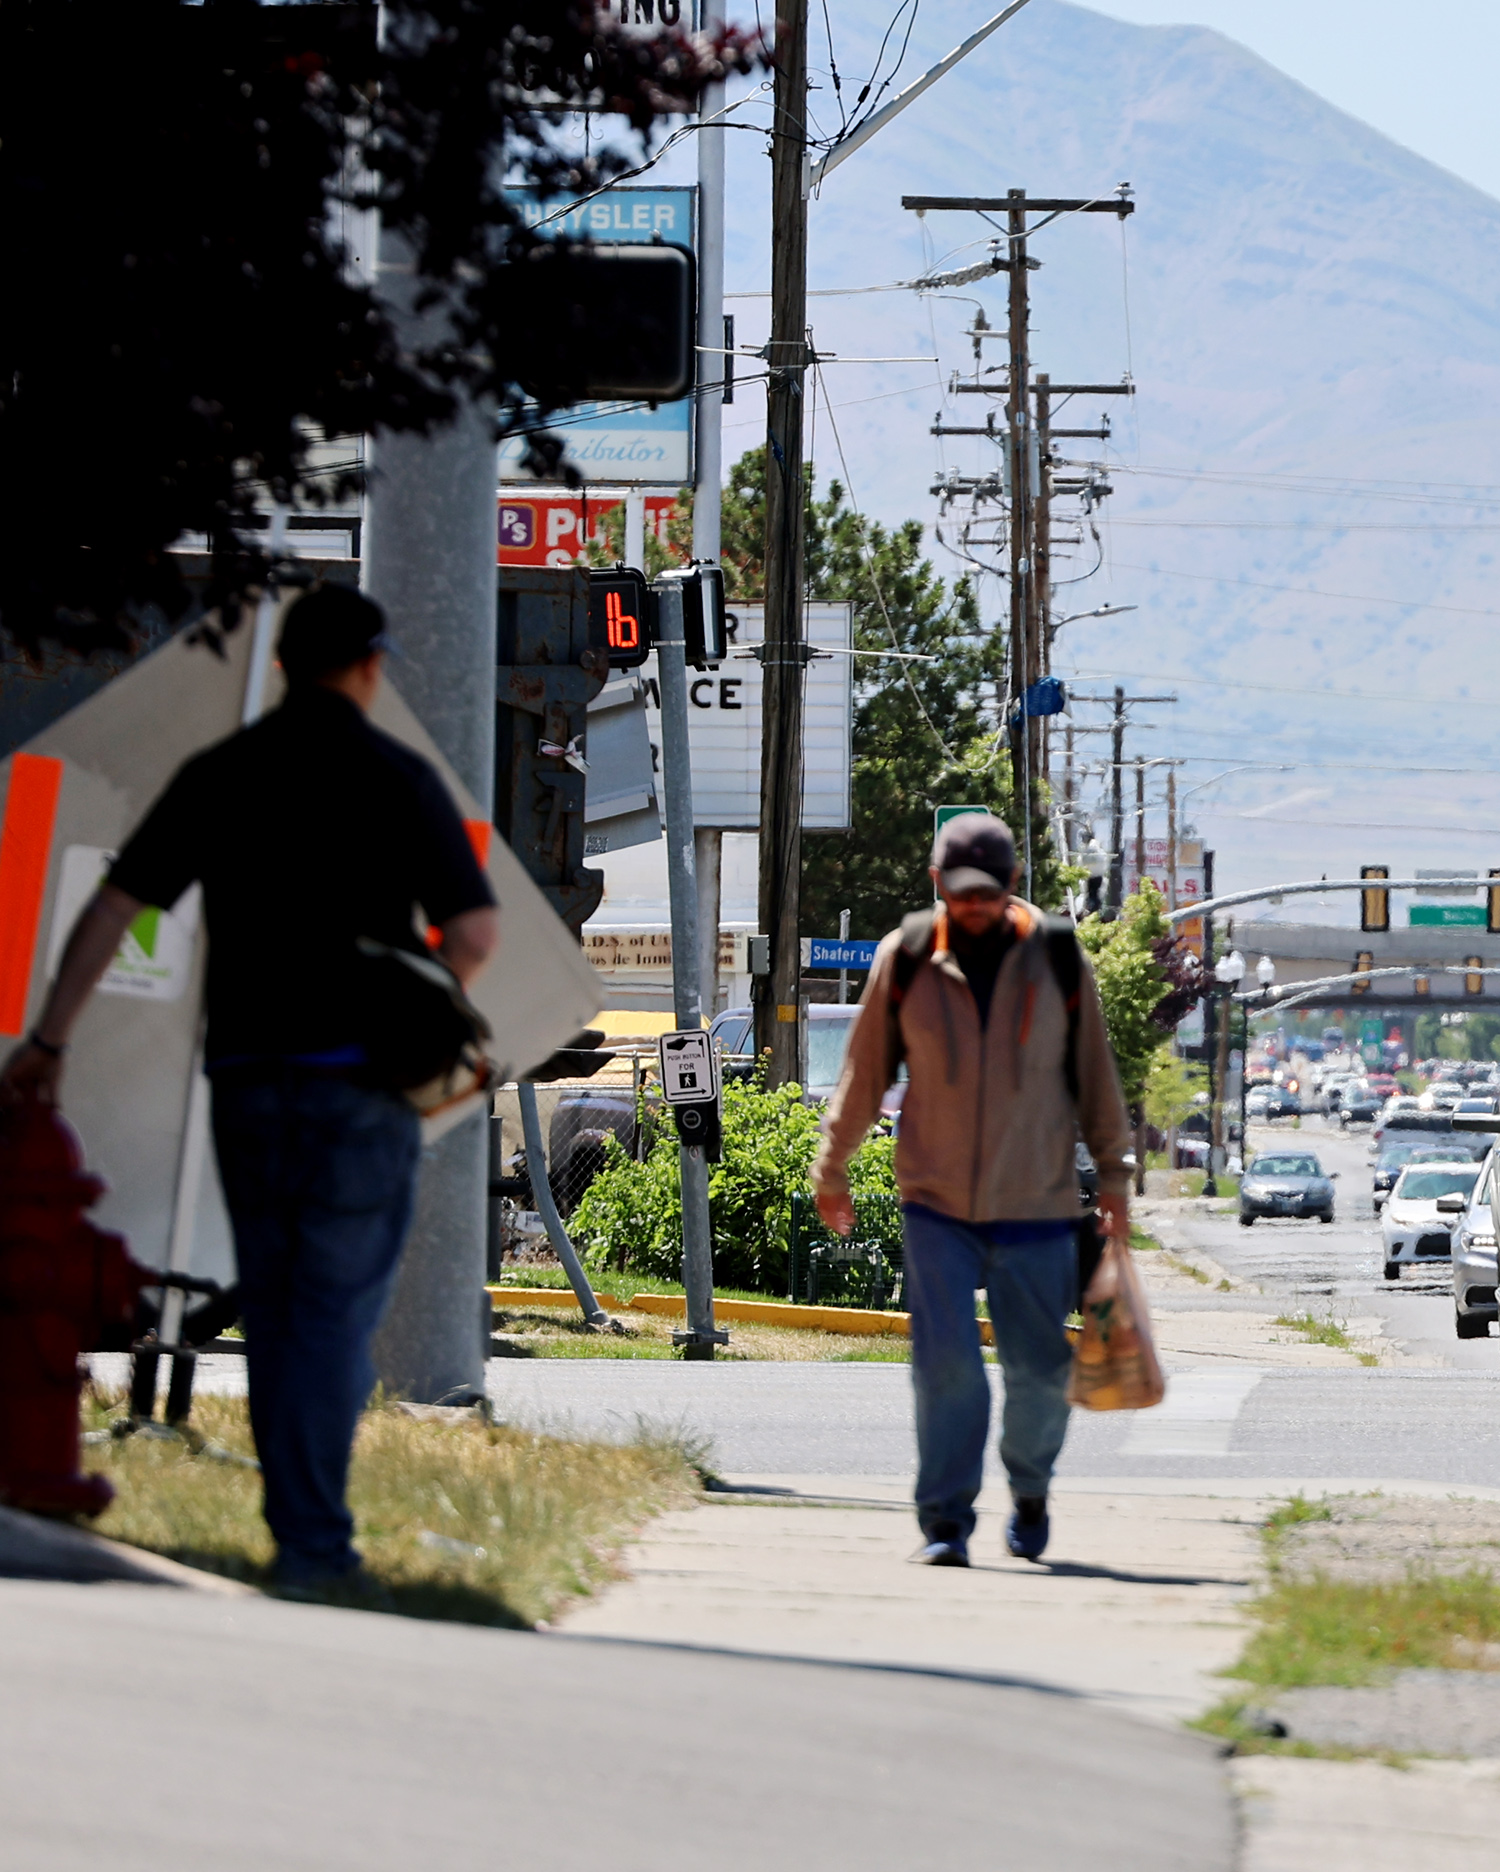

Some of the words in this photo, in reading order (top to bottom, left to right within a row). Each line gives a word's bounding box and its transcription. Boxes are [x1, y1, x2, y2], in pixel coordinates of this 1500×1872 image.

[605, 592, 639, 648] 16
[629, 933, 644, 947] of
[613, 953, 630, 965] de
[813, 945, 856, 962] Shafer
[860, 950, 873, 961] Ln
